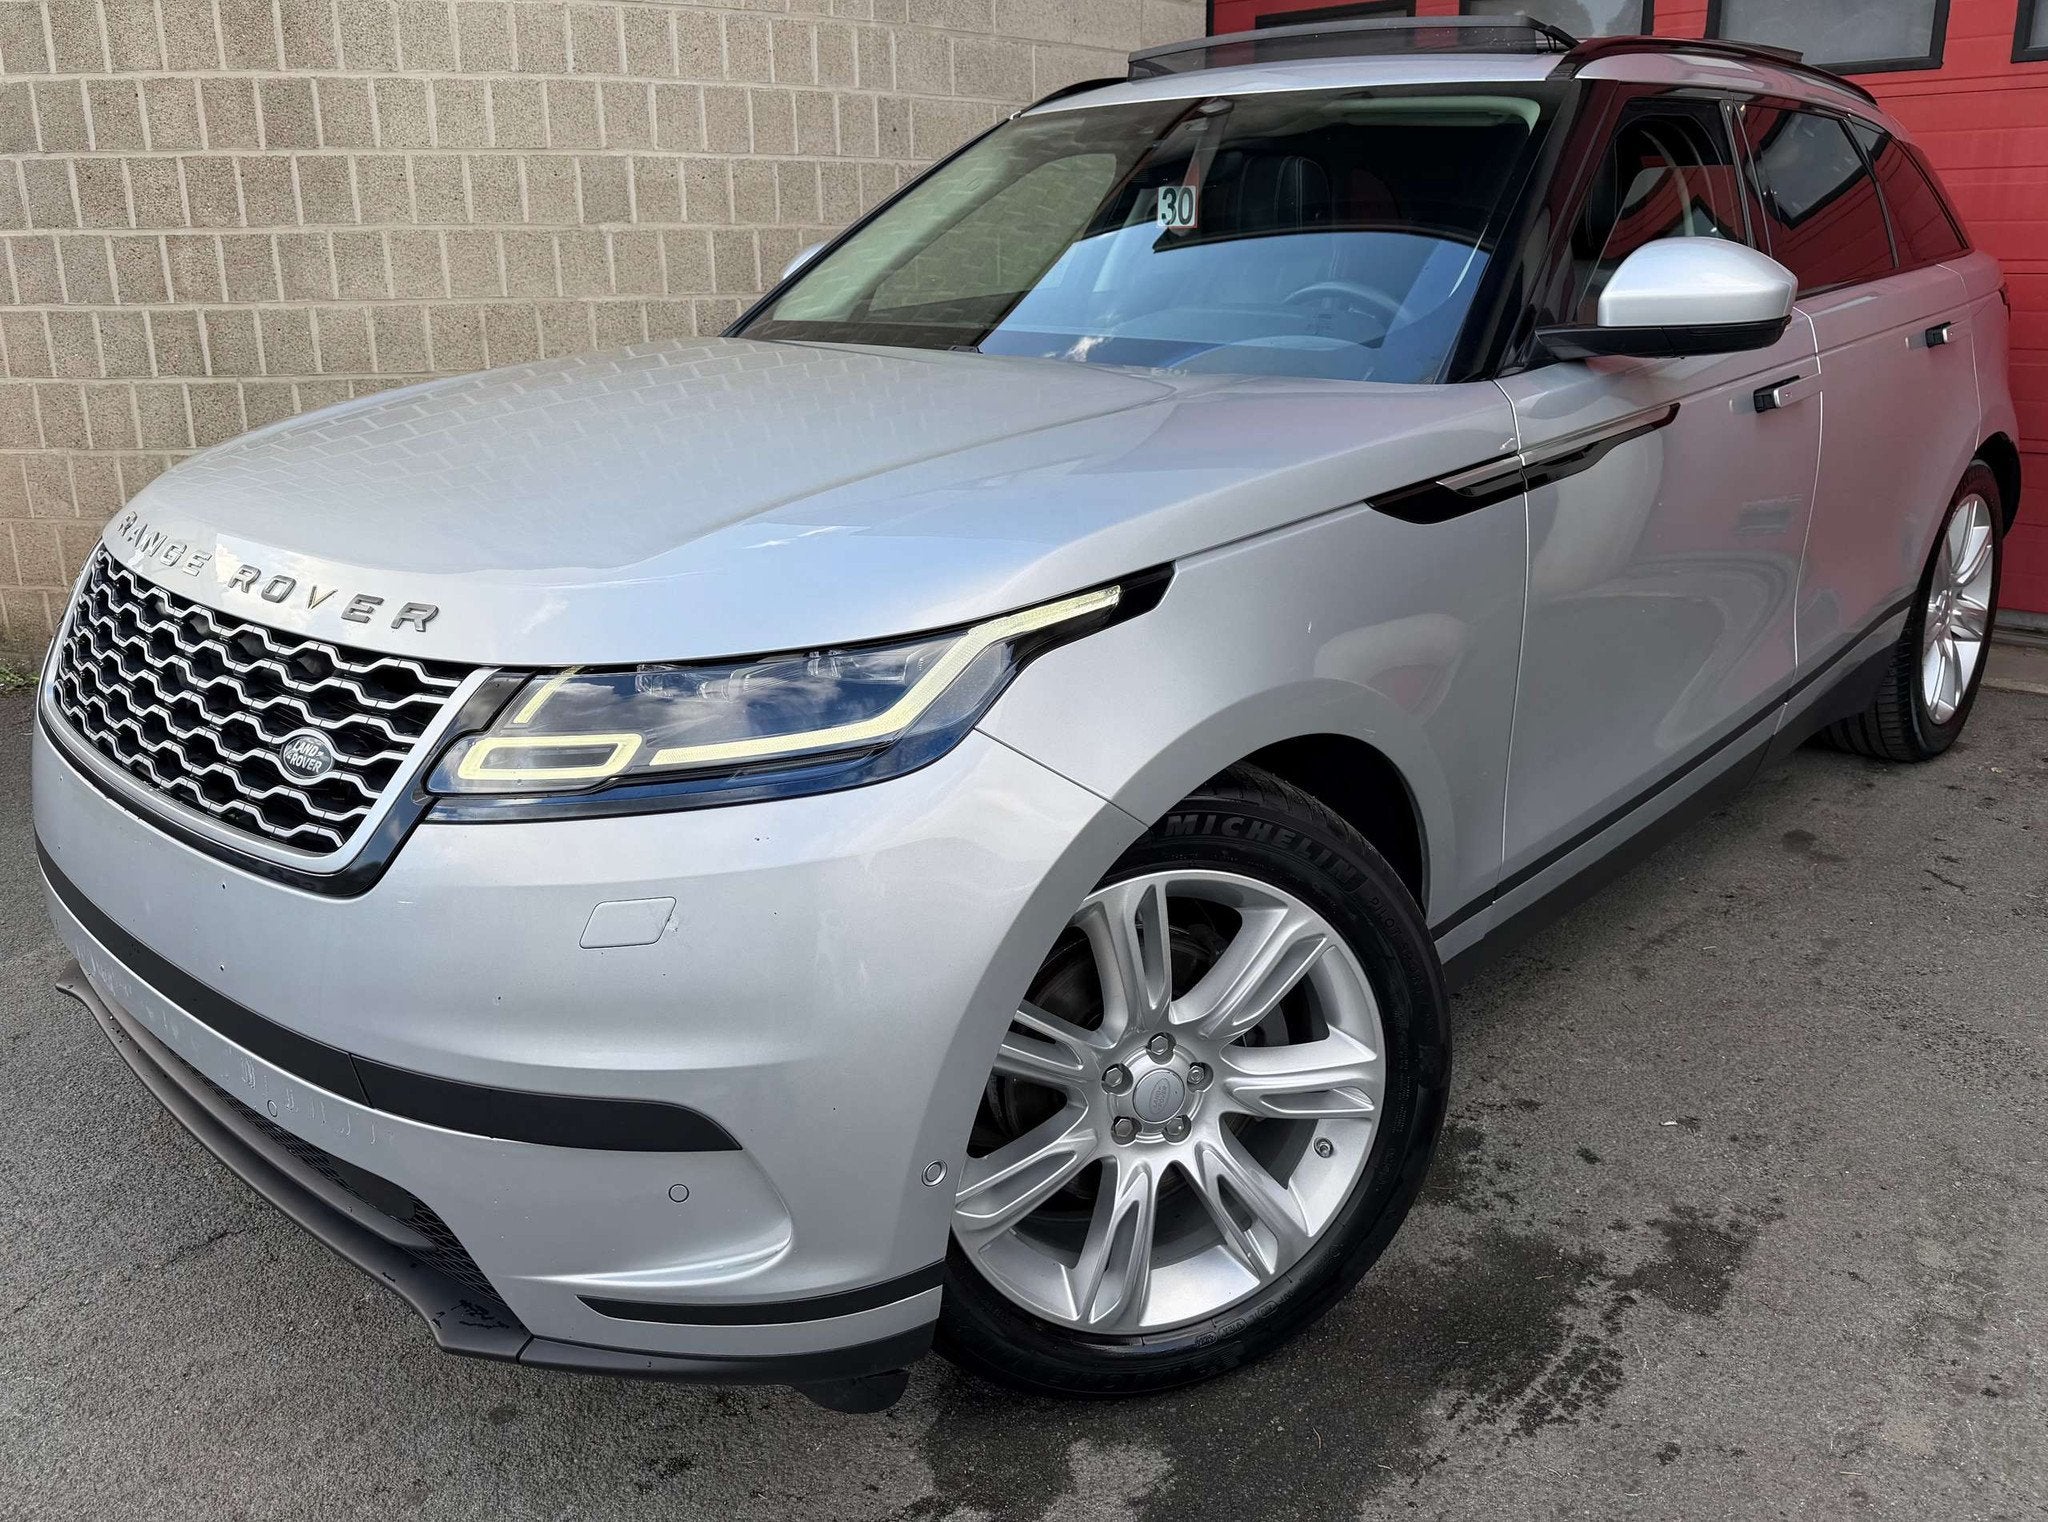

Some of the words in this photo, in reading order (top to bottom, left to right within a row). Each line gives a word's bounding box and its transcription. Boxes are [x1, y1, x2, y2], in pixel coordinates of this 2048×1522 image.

[1161, 187, 1194, 226] 30
[116, 510, 213, 577] RANGE
[227, 564, 440, 632] ROVER
[290, 753, 322, 772] ROVER
[292, 740, 319, 757] LAND
[1164, 814, 1361, 885] MICHELIN
